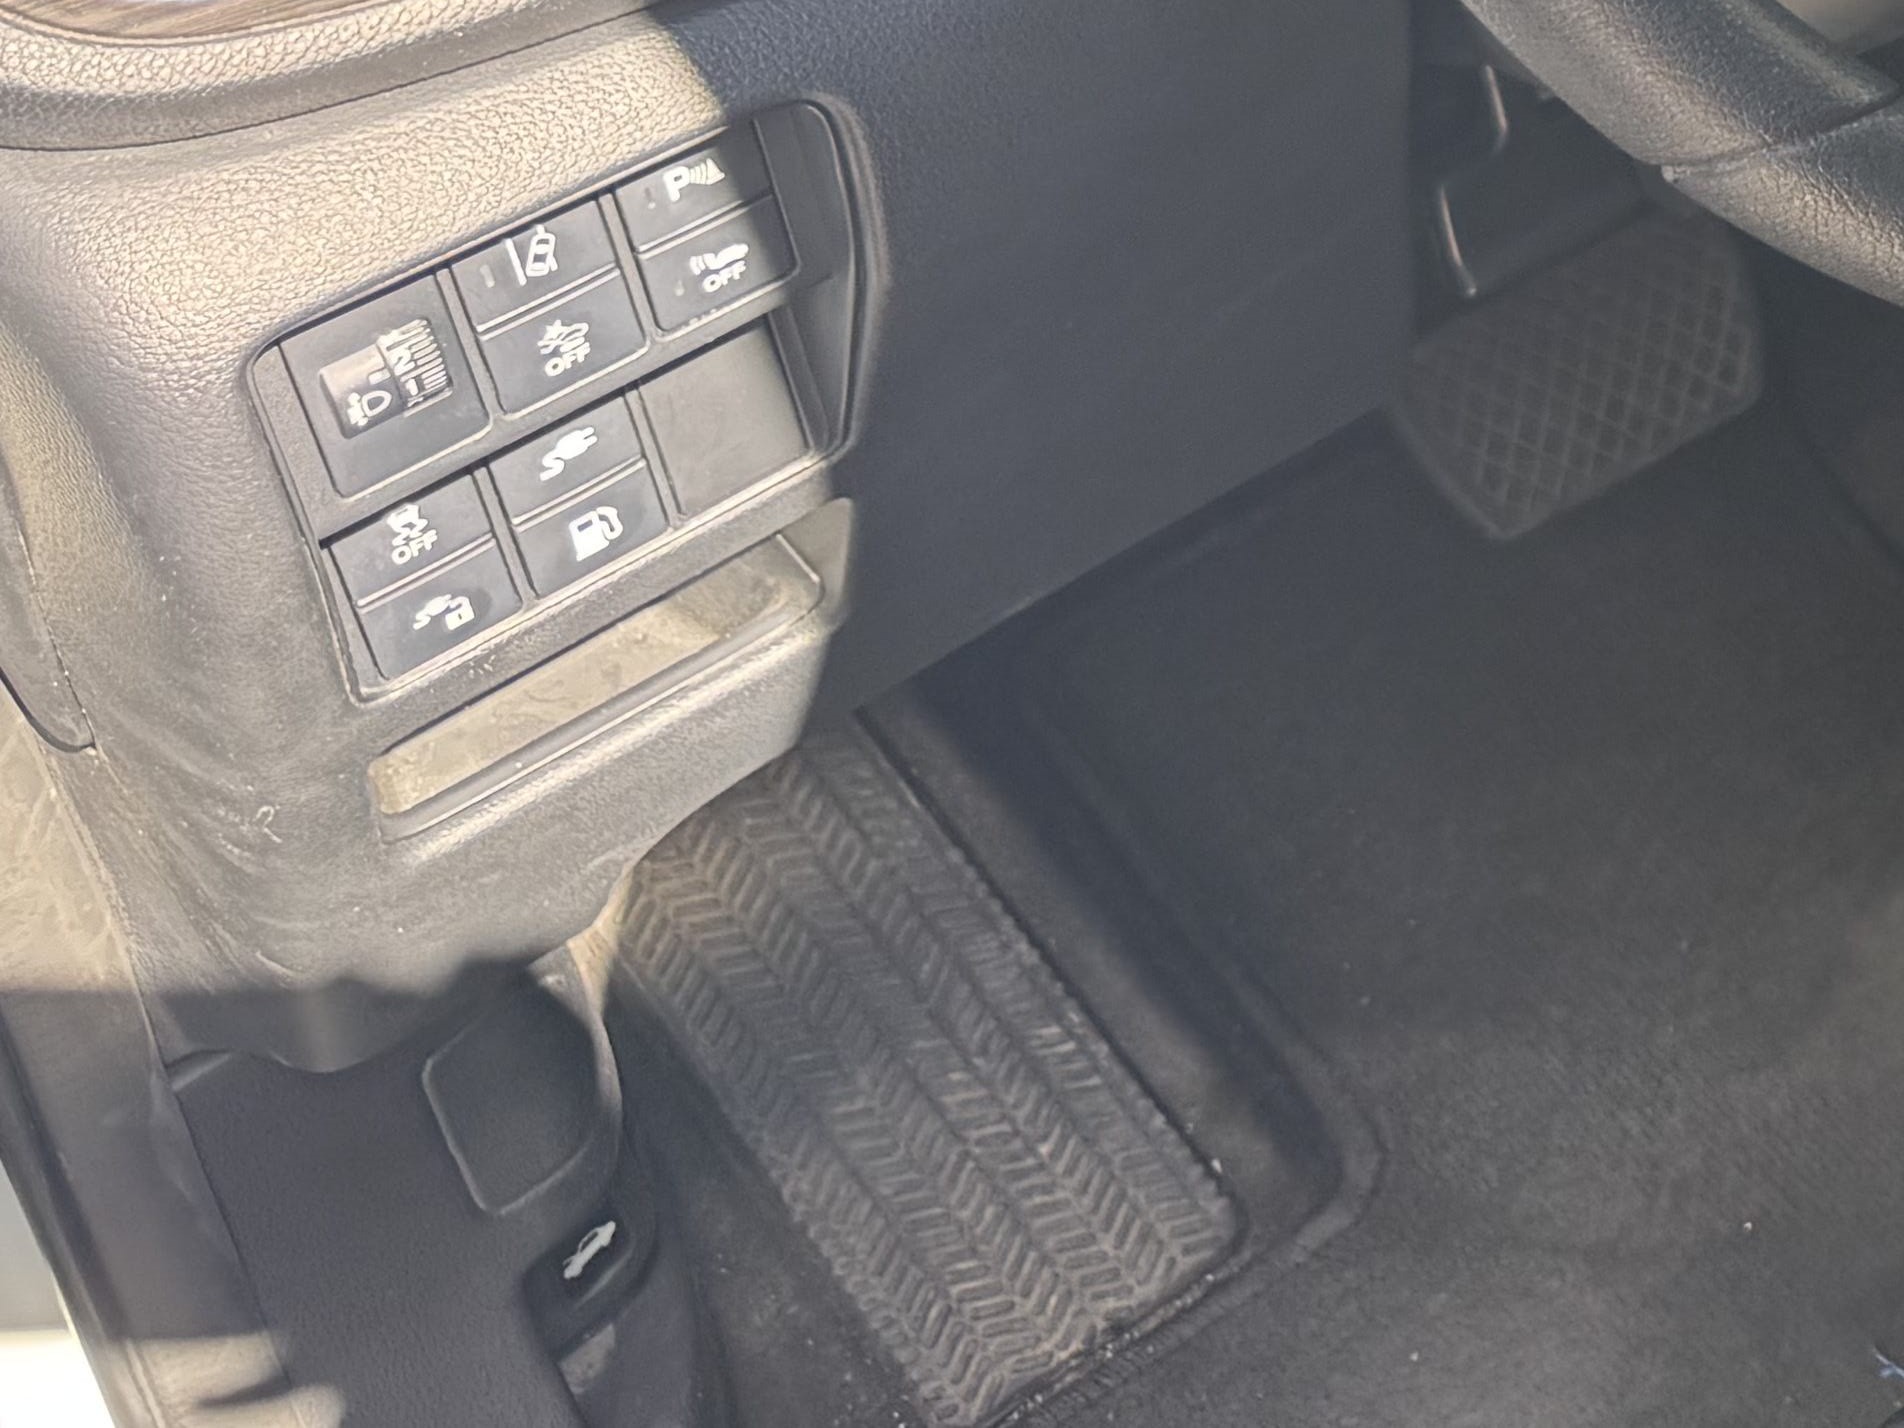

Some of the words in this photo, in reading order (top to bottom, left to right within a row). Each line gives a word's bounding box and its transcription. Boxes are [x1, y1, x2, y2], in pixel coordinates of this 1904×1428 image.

[702, 263, 747, 294] OFF
[543, 343, 592, 378] OFF
[391, 530, 438, 565] OFF
